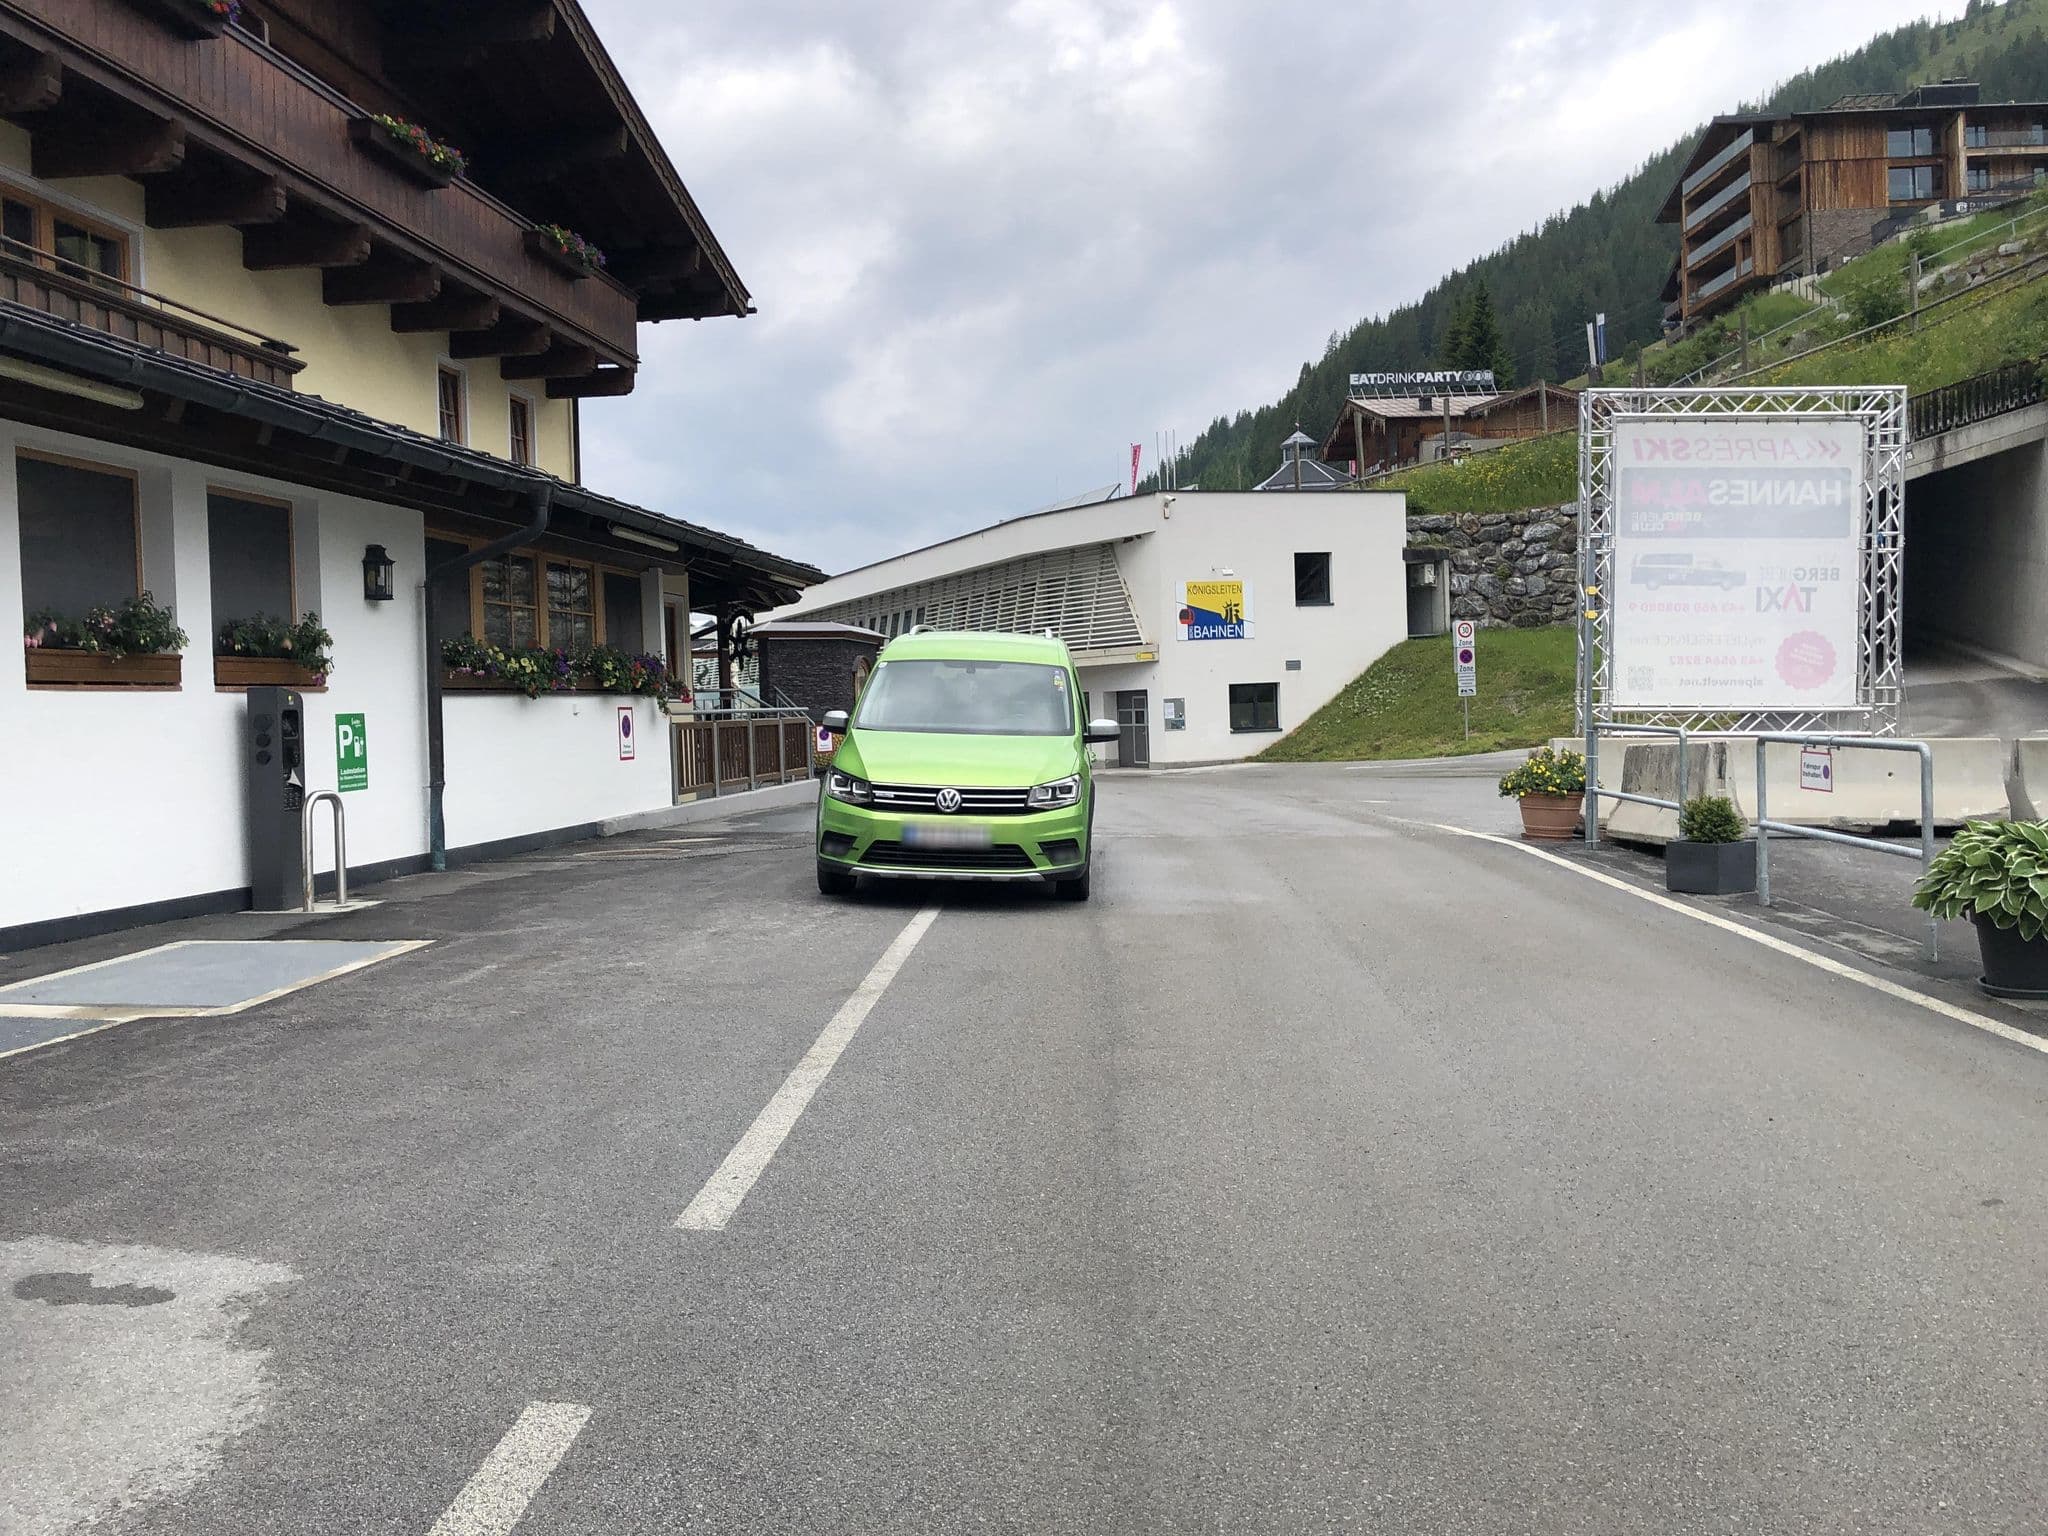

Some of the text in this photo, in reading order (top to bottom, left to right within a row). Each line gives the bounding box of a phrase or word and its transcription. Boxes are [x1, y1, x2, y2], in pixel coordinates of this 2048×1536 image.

[1187, 584, 1242, 595] KÖNIGSLEITEN
[1194, 624, 1244, 639] BAHNEN
[1461, 626, 1469, 634] 30
[1459, 665, 1474, 673] Zone
[338, 724, 353, 759] P
